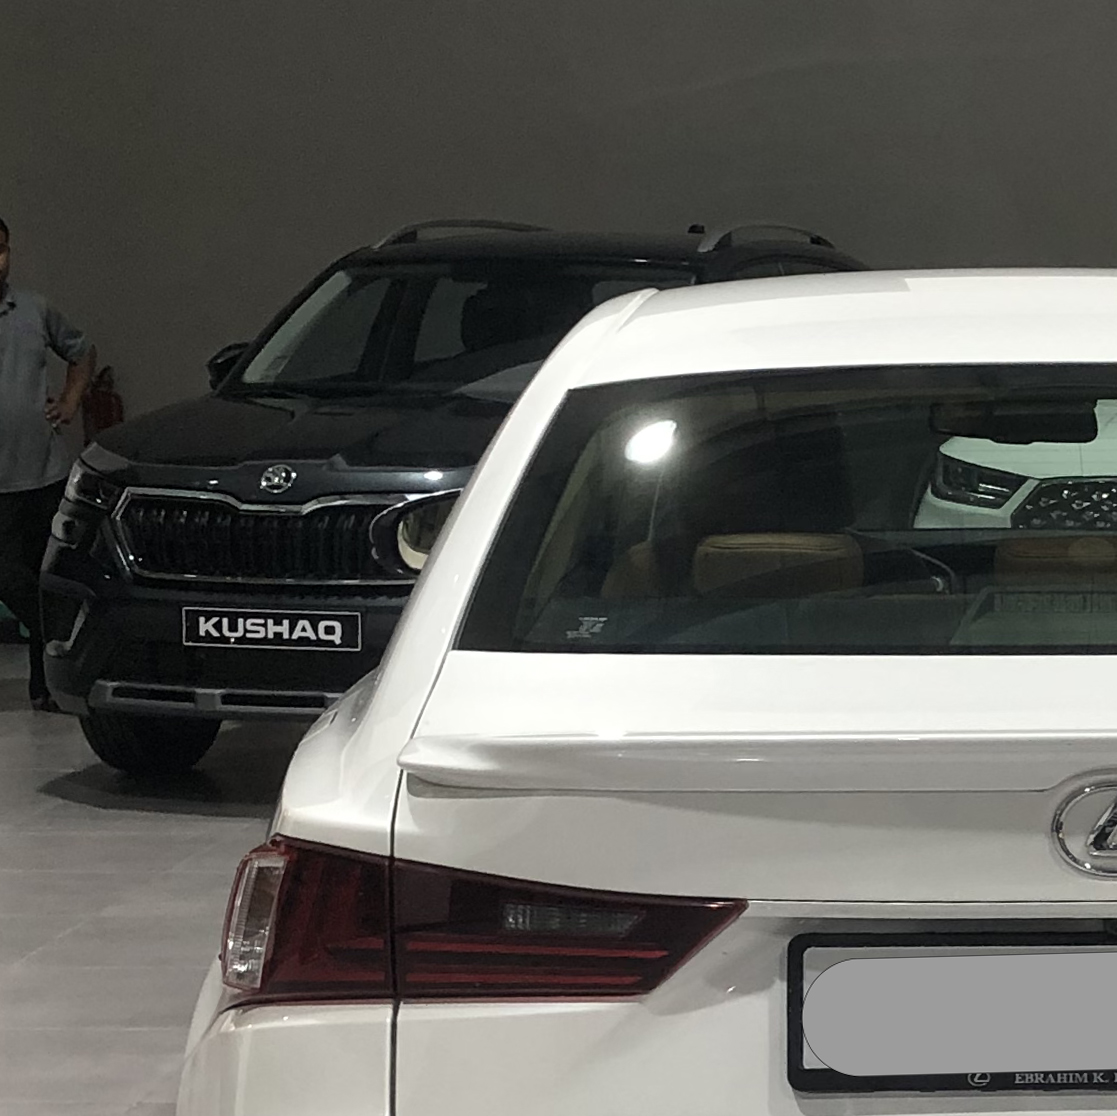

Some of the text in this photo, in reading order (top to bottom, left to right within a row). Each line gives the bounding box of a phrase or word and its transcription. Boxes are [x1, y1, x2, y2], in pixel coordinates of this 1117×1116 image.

[198, 616, 343, 646] KUSHAQ
[1014, 1072, 1089, 1084] EBRAHIM
[1092, 1072, 1109, 1084] K.
